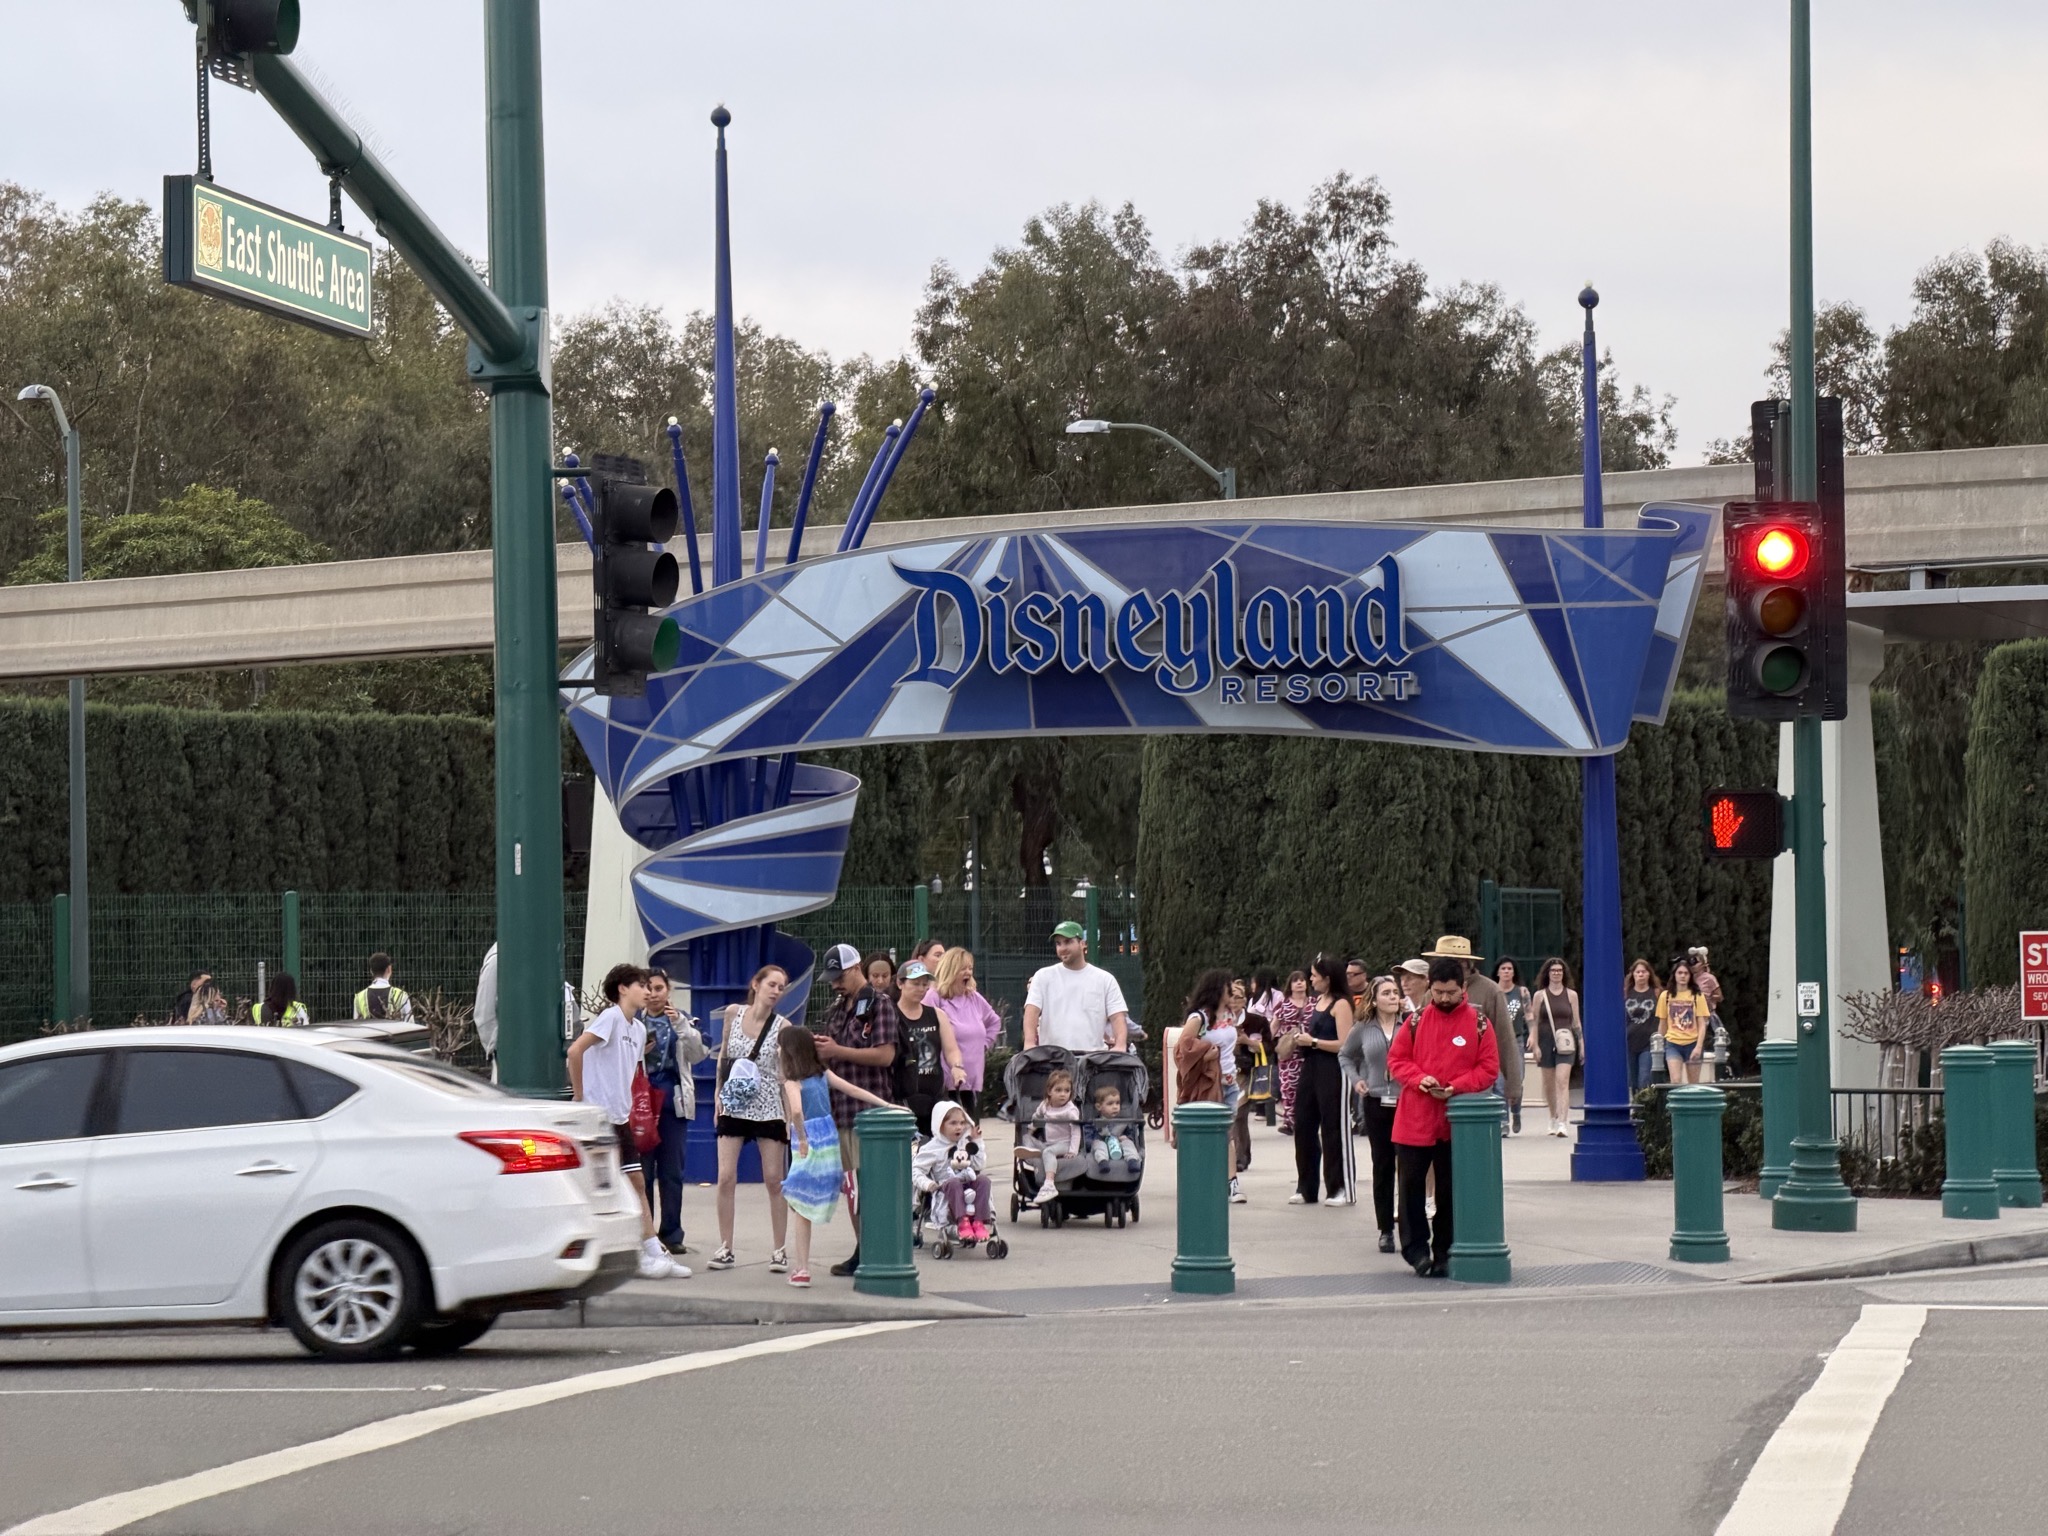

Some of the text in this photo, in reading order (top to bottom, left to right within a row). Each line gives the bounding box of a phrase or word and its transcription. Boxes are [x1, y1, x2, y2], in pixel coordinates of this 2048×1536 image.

[226, 215, 365, 314] East Shuttle Area
[888, 553, 1414, 693] Disneyland
[1220, 672, 1412, 704] RESORT
